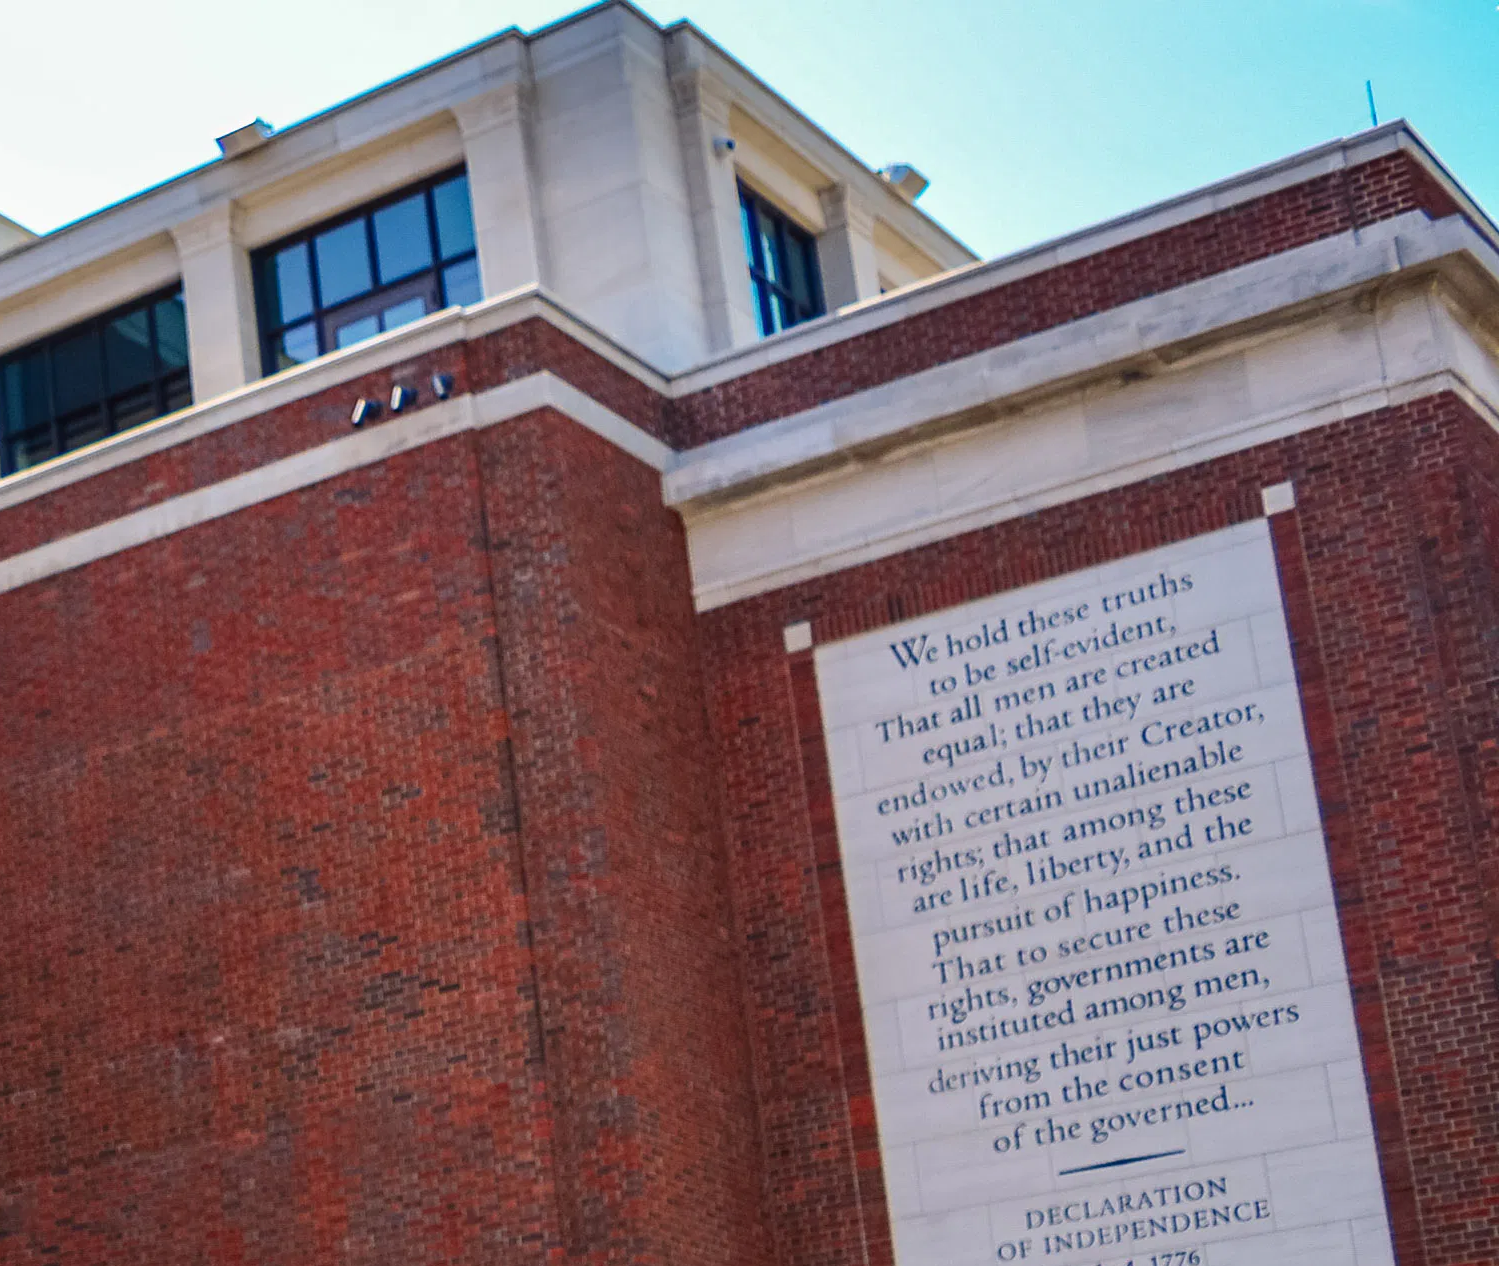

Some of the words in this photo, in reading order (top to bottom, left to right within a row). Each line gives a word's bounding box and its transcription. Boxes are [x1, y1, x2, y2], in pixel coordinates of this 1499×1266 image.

[888, 634, 939, 670] We
[944, 618, 1010, 657] hold
[1017, 601, 1090, 639] these
[1101, 571, 1195, 615] truths
[929, 675, 958, 698] to
[964, 662, 998, 689] be
[1005, 612, 1178, 679] self-evident,
[875, 713, 942, 744] That
[949, 697, 984, 724] all
[993, 684, 1057, 714] men
[1065, 669, 1108, 694] are
[1114, 629, 1222, 681] created
[921, 724, 1008, 769] equal;
[1013, 708, 1074, 742] that
[1081, 691, 1142, 727] they
[1151, 678, 1197, 705] are
[876, 764, 1016, 818] endowed,
[1019, 748, 1054, 785] by
[1060, 734, 1131, 770] their
[1140, 700, 1266, 748] Creator,
[890, 810, 954, 848] with
[963, 787, 1064, 830] certain
[1072, 739, 1246, 803] unalienable
[895, 842, 987, 887] rights;
[991, 830, 1051, 862] that
[1062, 802, 1164, 844] among
[1173, 776, 1254, 817] these
[912, 889, 954, 914] are
[960, 868, 1020, 904] life,
[1026, 842, 1131, 887] liberty,
[1137, 825, 1195, 861] and
[1204, 813, 1254, 844] the
[931, 908, 1035, 957] pursuit
[1043, 892, 1077, 923] of
[1083, 863, 1242, 917] happiness.
[931, 951, 1007, 985] That
[1015, 943, 1048, 967] to
[1057, 920, 1153, 957] secure
[1162, 899, 1241, 935] these
[926, 985, 1020, 1025] rights,
[1027, 937, 1216, 1006] governments
[1224, 927, 1272, 954] are
[936, 1000, 1076, 1052] instituted
[1084, 981, 1185, 1021] among
[1194, 966, 1272, 999] men,
[927, 1052, 1041, 1096] deriving
[1048, 1036, 1118, 1073] their
[1124, 1025, 1184, 1064] just
[1192, 1002, 1301, 1050] powers
[977, 1092, 1051, 1123] from
[1061, 1074, 1110, 1104] the
[1117, 1047, 1246, 1093] consent
[992, 1126, 1026, 1156] of
[1034, 1115, 1082, 1145] the
[1089, 1084, 1255, 1144] governed...
[996, 1238, 1033, 1263] OF
[1043, 1198, 1272, 1256] INDEPENDENCE
[1024, 1176, 1229, 1231] DECLARATION
